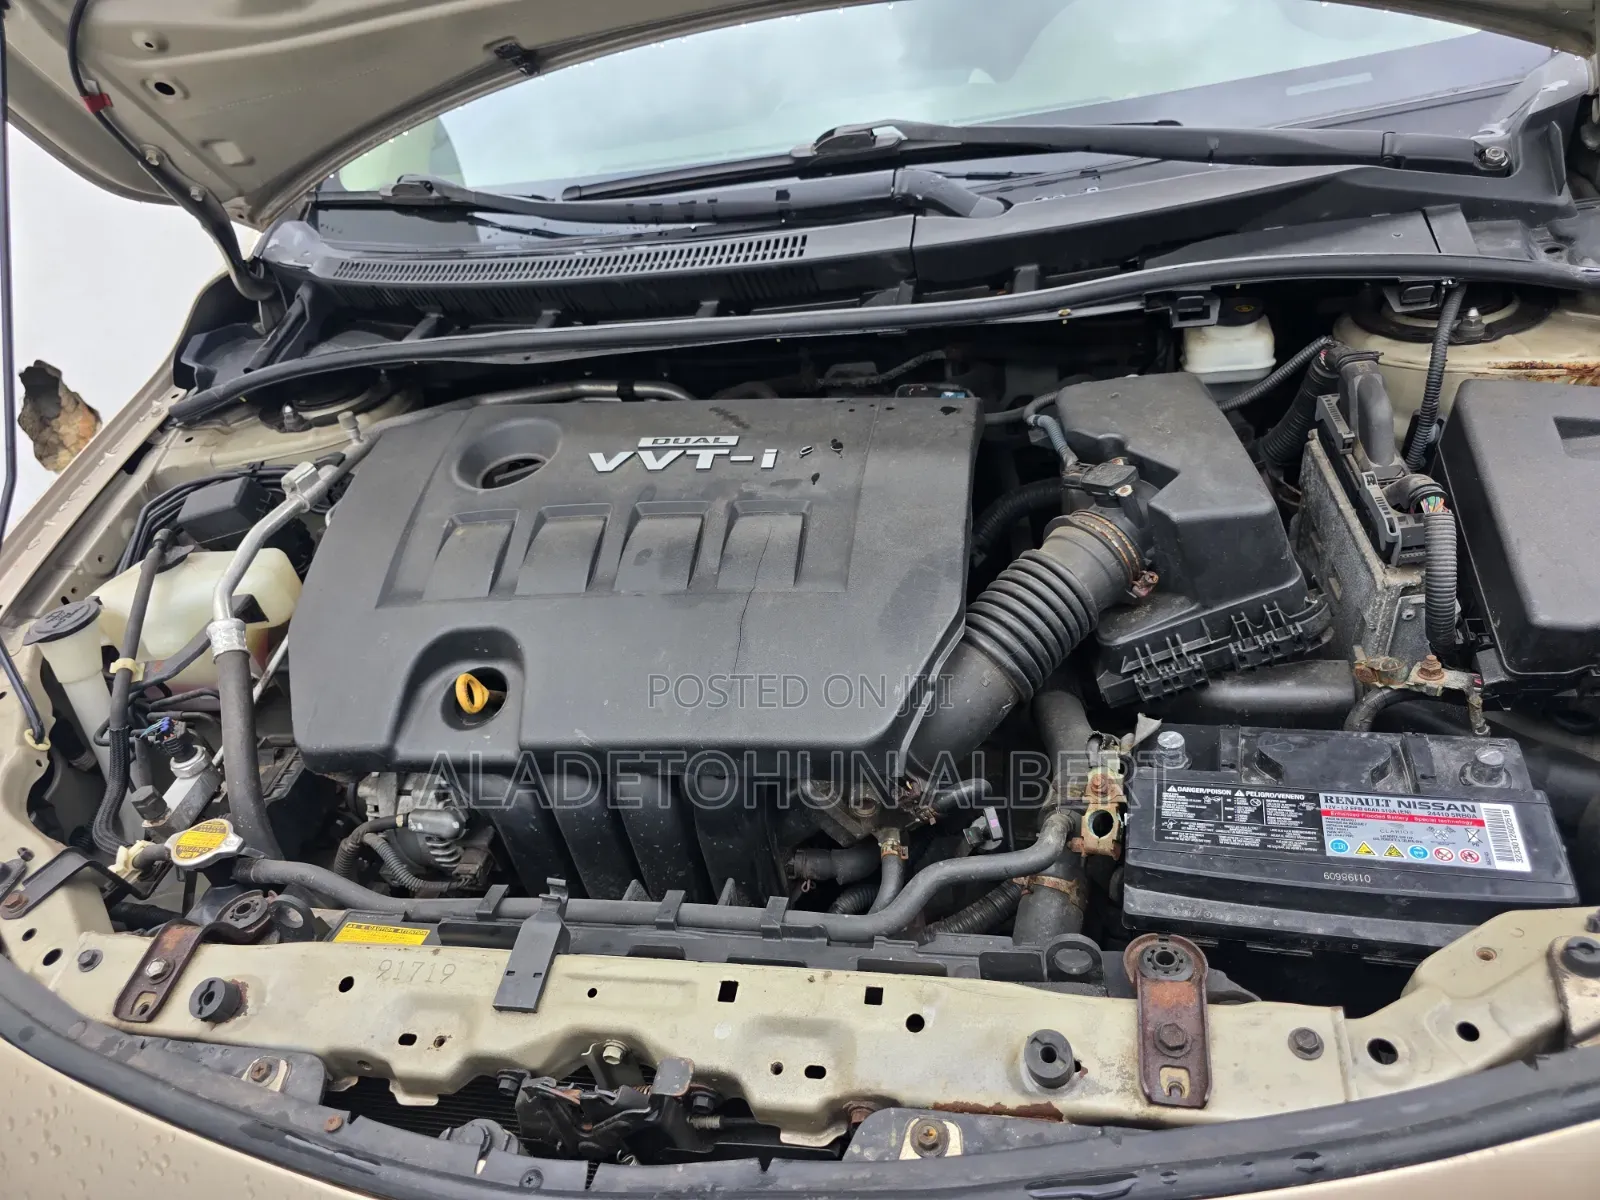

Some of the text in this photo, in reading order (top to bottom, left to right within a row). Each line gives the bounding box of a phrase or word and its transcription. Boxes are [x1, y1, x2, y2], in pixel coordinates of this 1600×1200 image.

[651, 436, 729, 446] DUAL
[588, 448, 779, 473] VVT-i
[1177, 786, 1232, 796] DANGER/POISON
[1245, 791, 1304, 800] PELIGRO/VENENO
[1323, 795, 1476, 812] RENAULT NISSAN
[1386, 814, 1409, 822] Battery
[1438, 818, 1473, 826] technology
